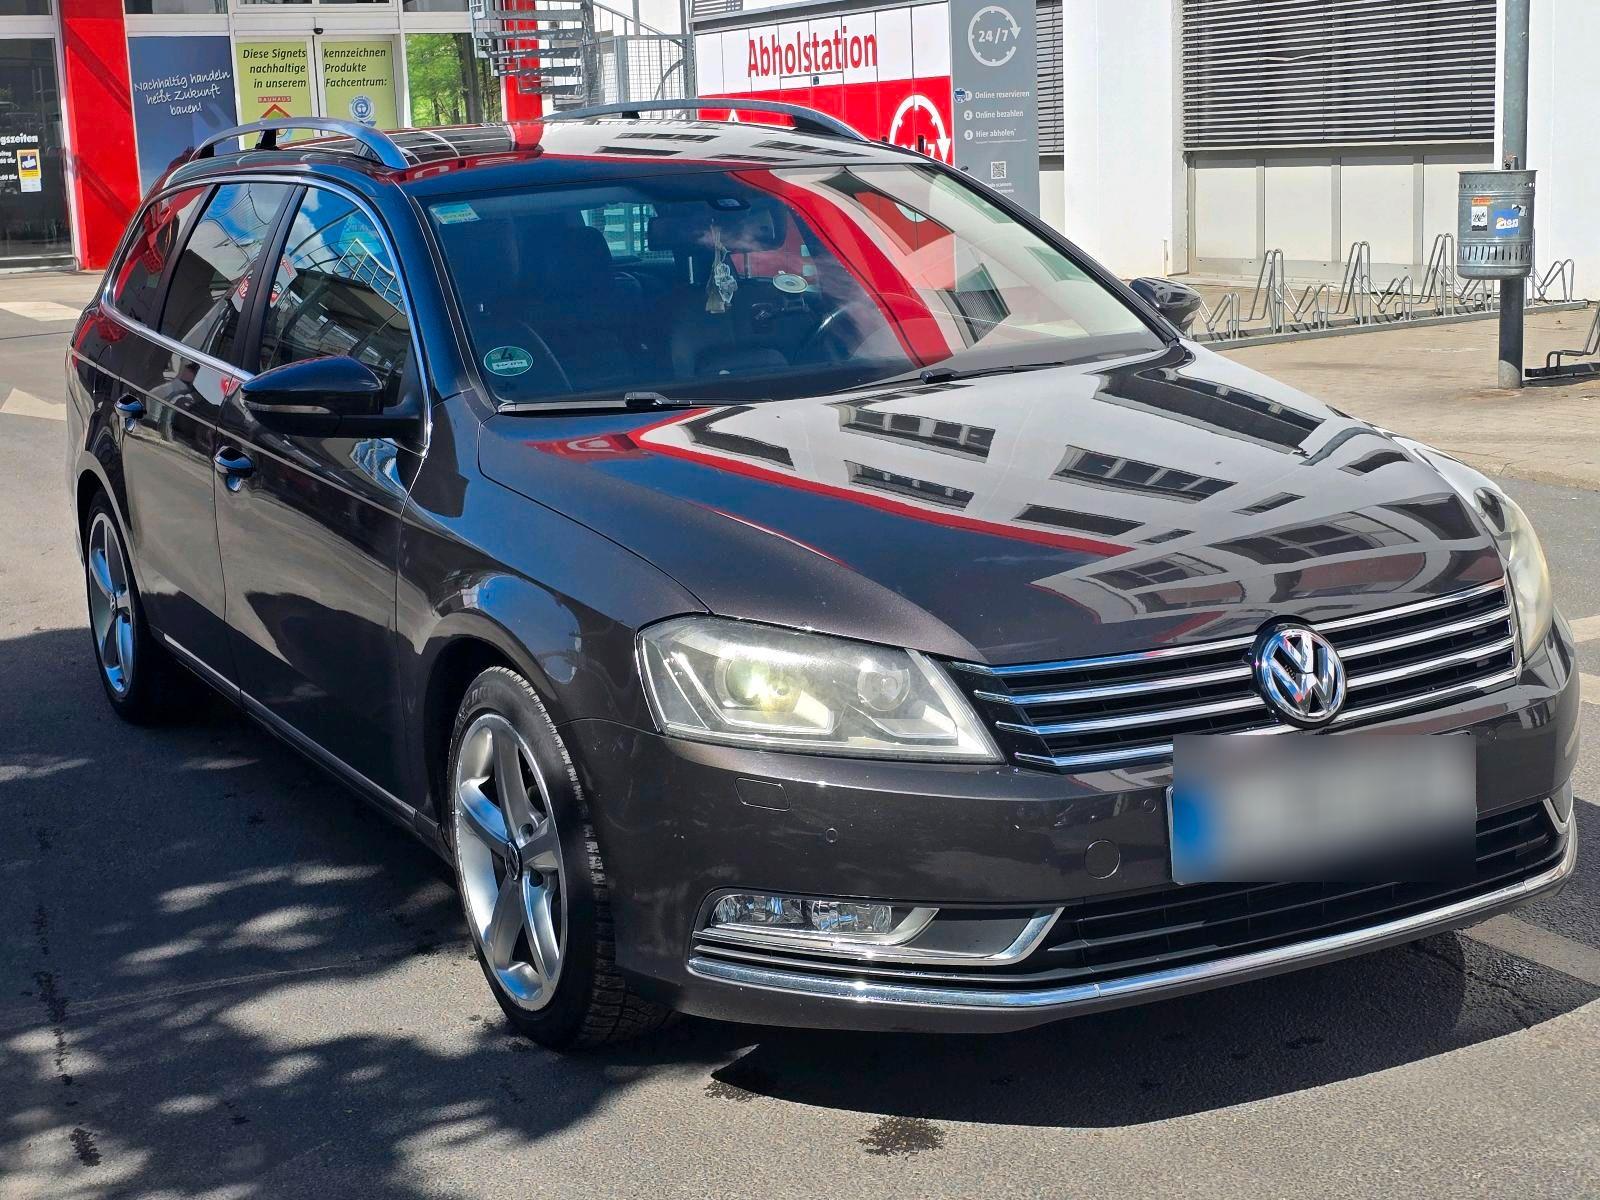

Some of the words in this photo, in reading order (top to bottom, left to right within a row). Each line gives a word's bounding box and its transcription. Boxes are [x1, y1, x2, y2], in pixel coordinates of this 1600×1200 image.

[978, 28, 1008, 44] 24/7
[243, 49, 269, 59] Diese
[272, 49, 306, 60] Signets
[324, 48, 386, 58] kennzeichnen
[747, 26, 877, 77] Abholstation
[250, 63, 306, 74] nachhaltige
[325, 63, 367, 73] Produkte
[134, 74, 188, 91] Nachhaltig
[190, 69, 230, 83] handeln
[254, 78, 263, 88] in
[266, 79, 306, 88] unserem
[326, 77, 387, 87] Fachcentrum:
[146, 88, 172, 104] heißt
[174, 83, 220, 100] Zukunft
[996, 90, 1030, 98] reservieren
[169, 102, 202, 115] bauen!
[975, 111, 996, 119] Online
[996, 109, 1024, 118] bezahlen
[975, 130, 989, 138] Hier
